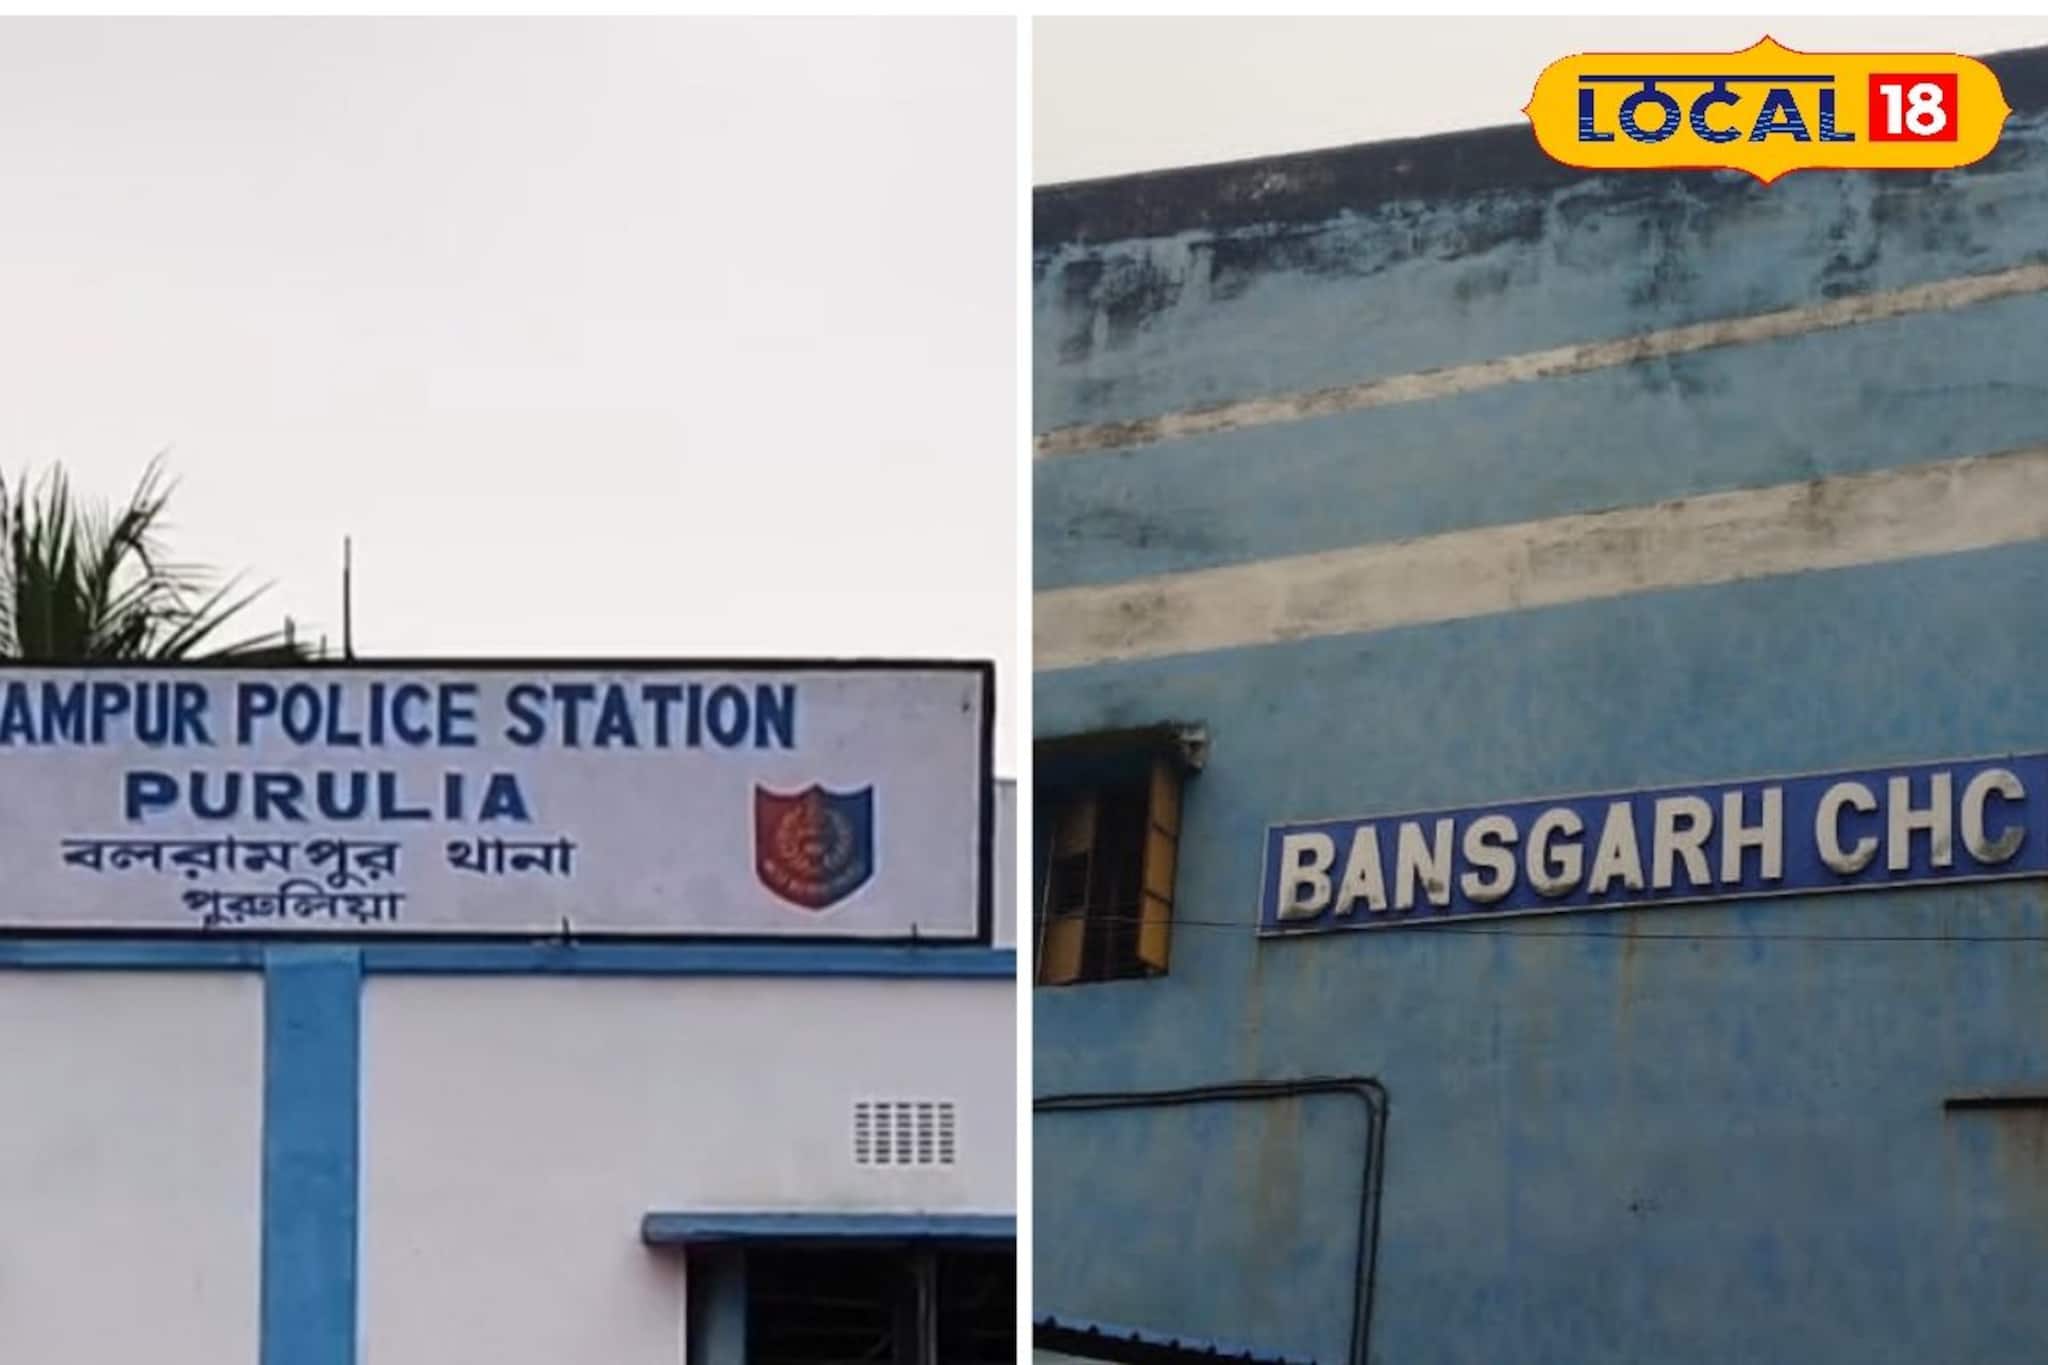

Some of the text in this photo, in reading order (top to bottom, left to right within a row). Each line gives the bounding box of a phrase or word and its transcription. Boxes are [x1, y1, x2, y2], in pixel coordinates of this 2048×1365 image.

[0, 681, 797, 749] AMPUR POLICE STATION
[124, 771, 532, 822] PURULIA
[446, 837, 577, 876] থানা
[1277, 768, 2026, 921] BANSGARH CHC
[181, 878, 406, 929] পুরুলিয়া
